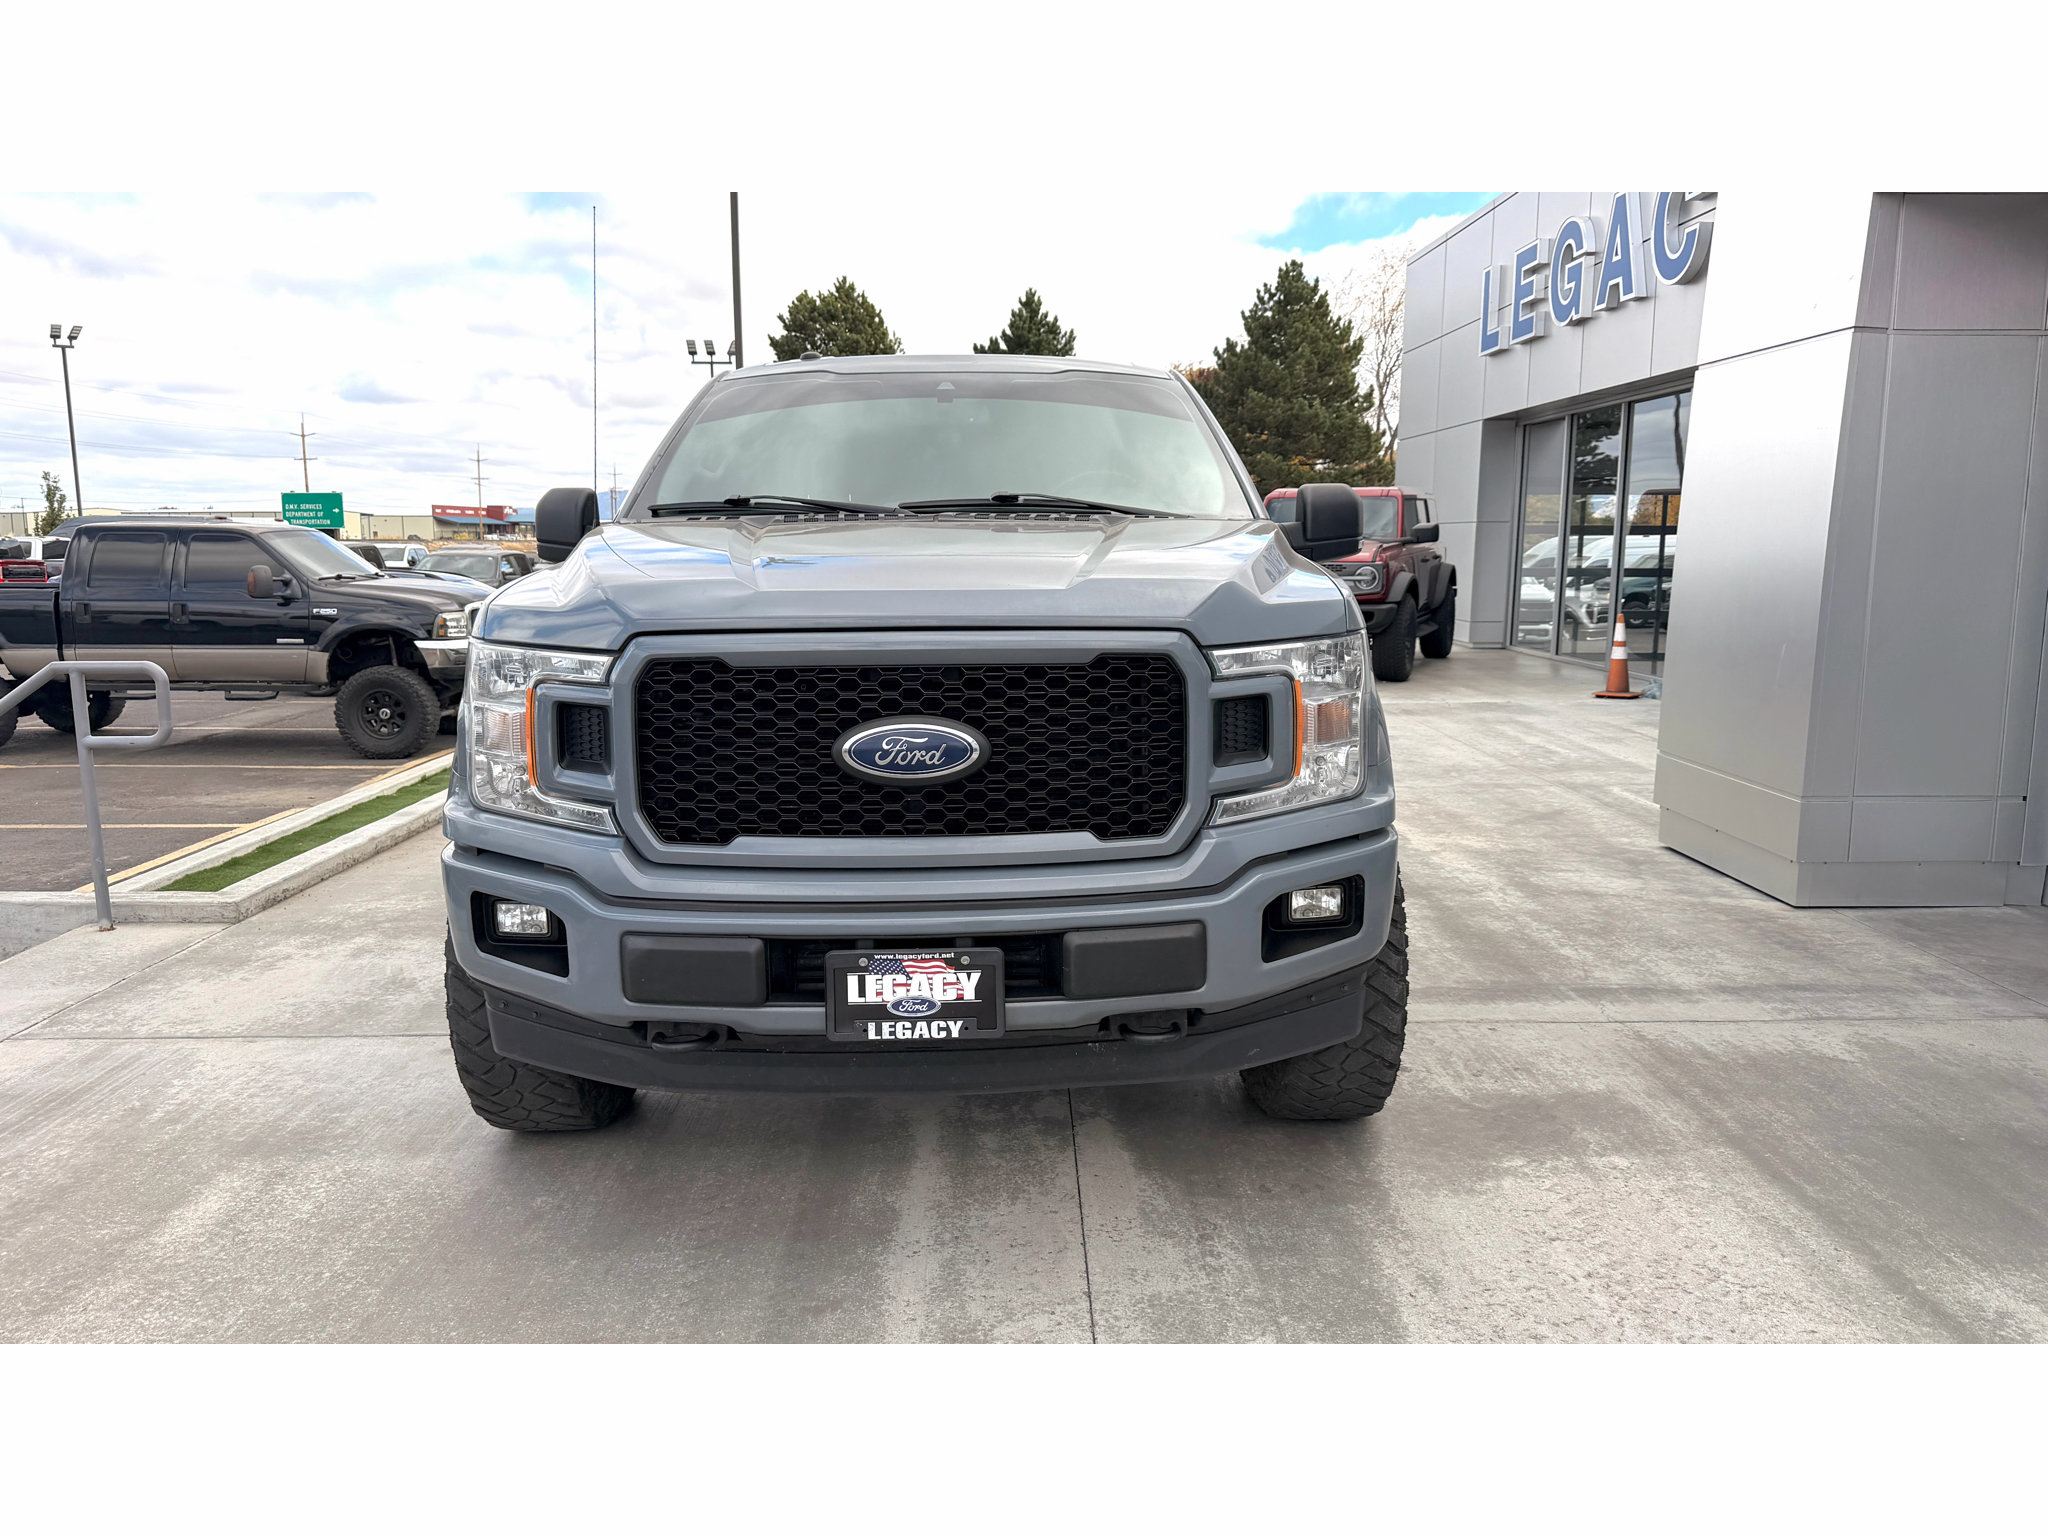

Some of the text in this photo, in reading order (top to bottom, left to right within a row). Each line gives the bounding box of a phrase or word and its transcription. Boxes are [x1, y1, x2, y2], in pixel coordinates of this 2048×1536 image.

[874, 736, 947, 766] Ford
[873, 952, 955, 960] www.legacyford.net
[846, 972, 982, 1002] LEGACY
[898, 999, 929, 1012] Ford
[867, 1020, 964, 1040] LEGACY
